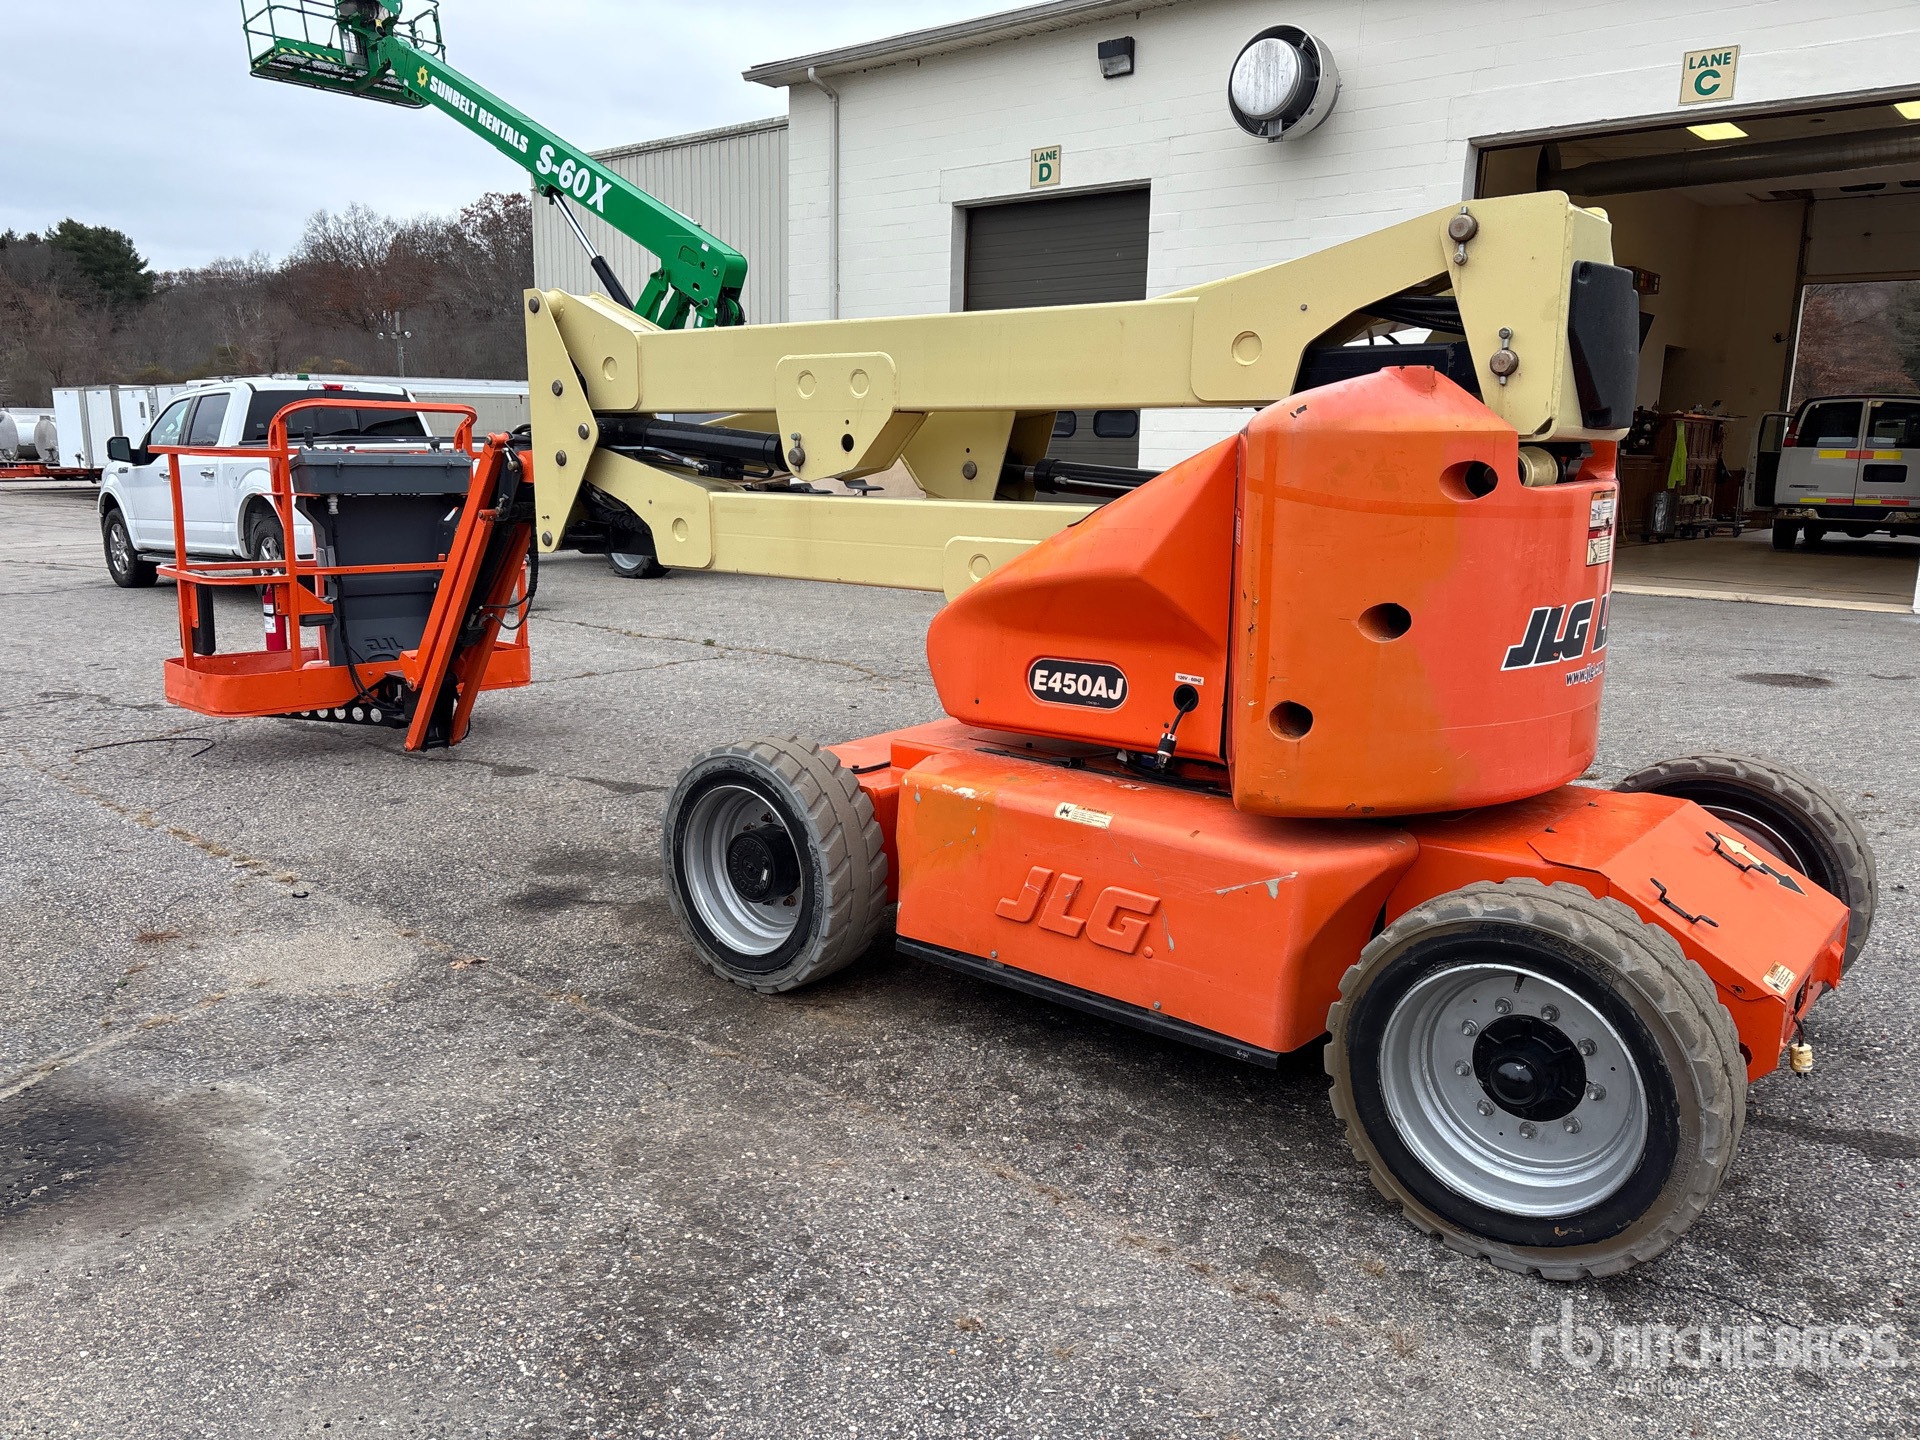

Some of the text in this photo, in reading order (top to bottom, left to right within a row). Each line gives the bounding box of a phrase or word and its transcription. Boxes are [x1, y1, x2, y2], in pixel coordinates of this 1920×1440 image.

[1688, 51, 1732, 70] LANE
[1694, 68, 1721, 96] C
[429, 75, 529, 154] SUNBELT RENTALS
[1034, 150, 1057, 163] LANE
[1038, 163, 1052, 182] D
[1500, 598, 1596, 672] JLG
[1033, 669, 1124, 700] E450AJ
[995, 865, 1160, 955] JLG
